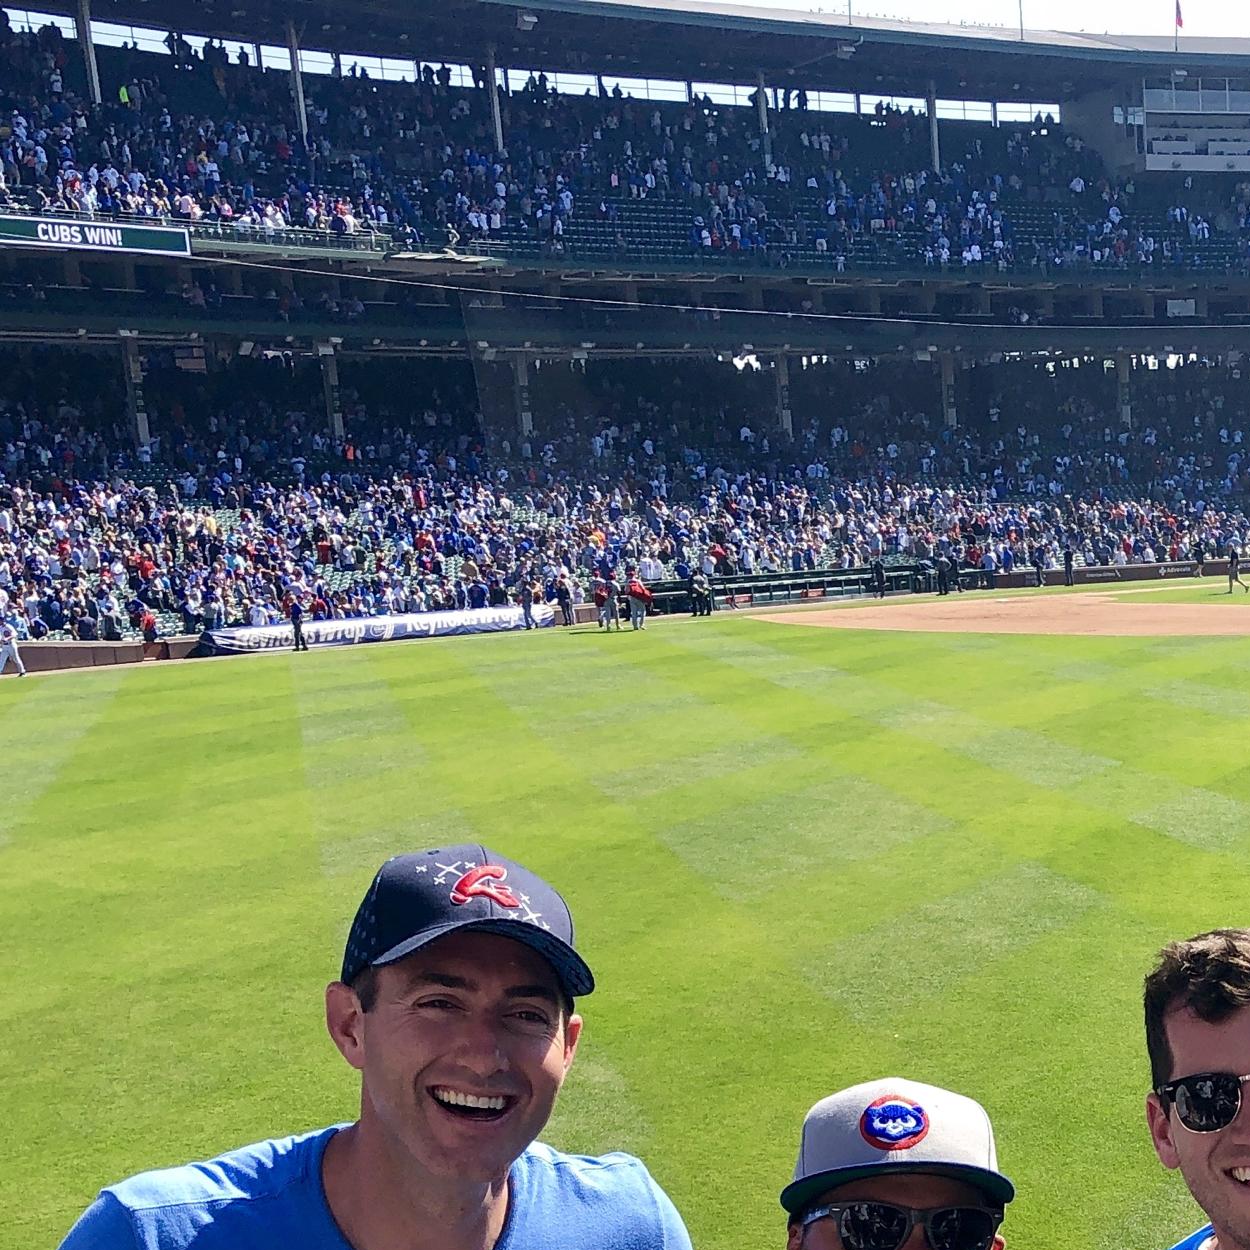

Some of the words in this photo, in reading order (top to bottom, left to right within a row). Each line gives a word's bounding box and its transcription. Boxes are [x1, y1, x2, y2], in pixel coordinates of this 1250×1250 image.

[37, 223, 82, 242] CUBS
[84, 226, 122, 246] WIN!
[237, 627, 316, 649] Reynos
